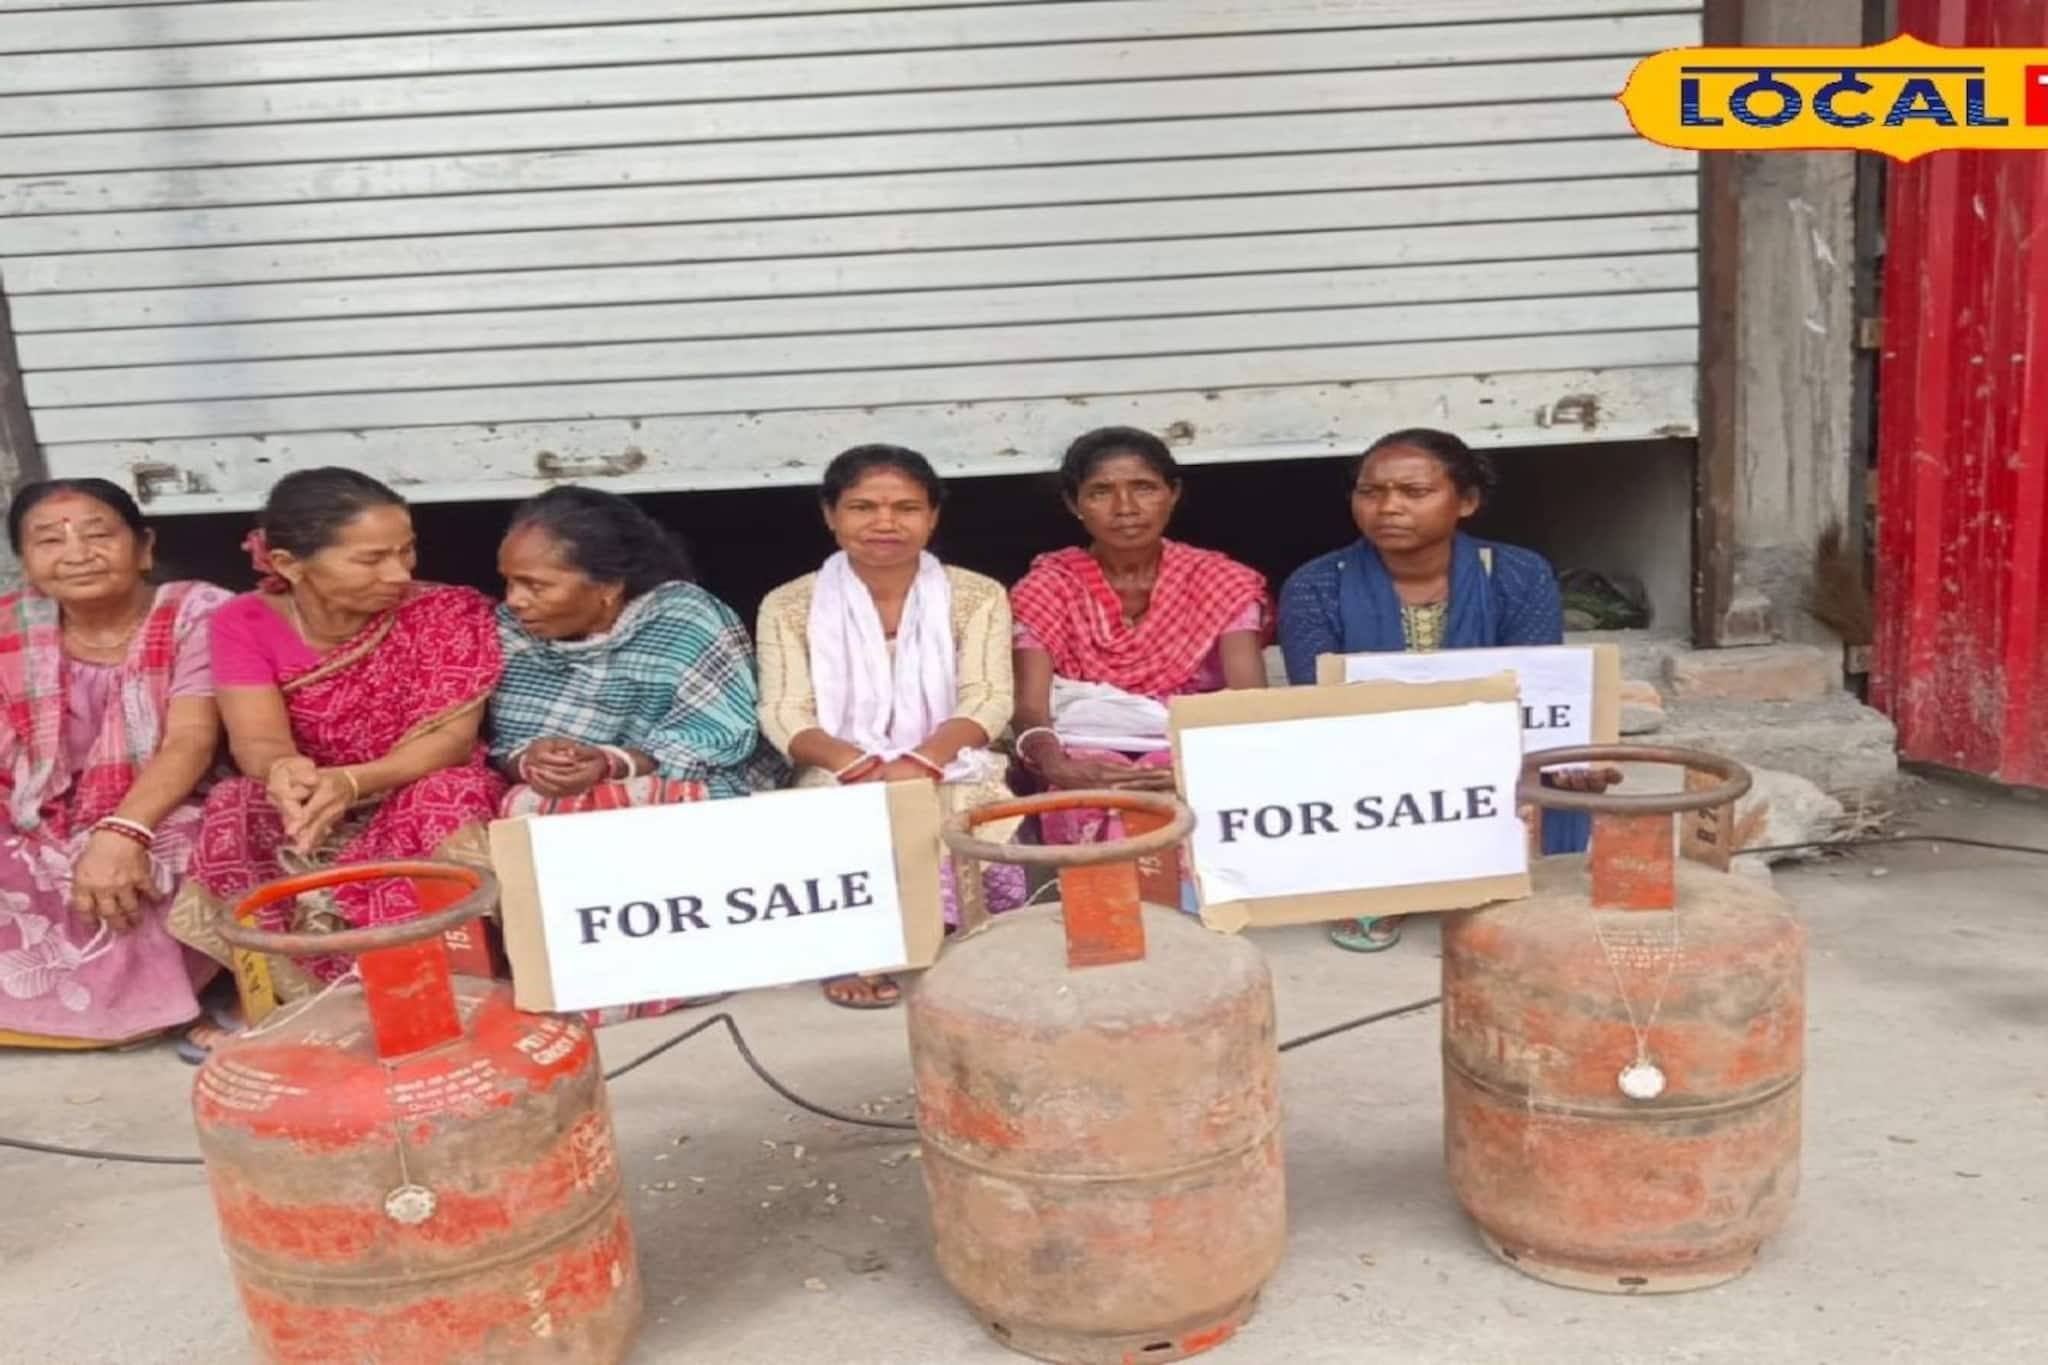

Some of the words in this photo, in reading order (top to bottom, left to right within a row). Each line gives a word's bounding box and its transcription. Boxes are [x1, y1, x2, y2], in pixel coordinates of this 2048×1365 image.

[1520, 704, 1571, 729] LE
[1217, 801, 1339, 843] FOR
[1355, 785, 1498, 831] SALE
[576, 895, 711, 944] FOR
[725, 871, 873, 926] SALE
